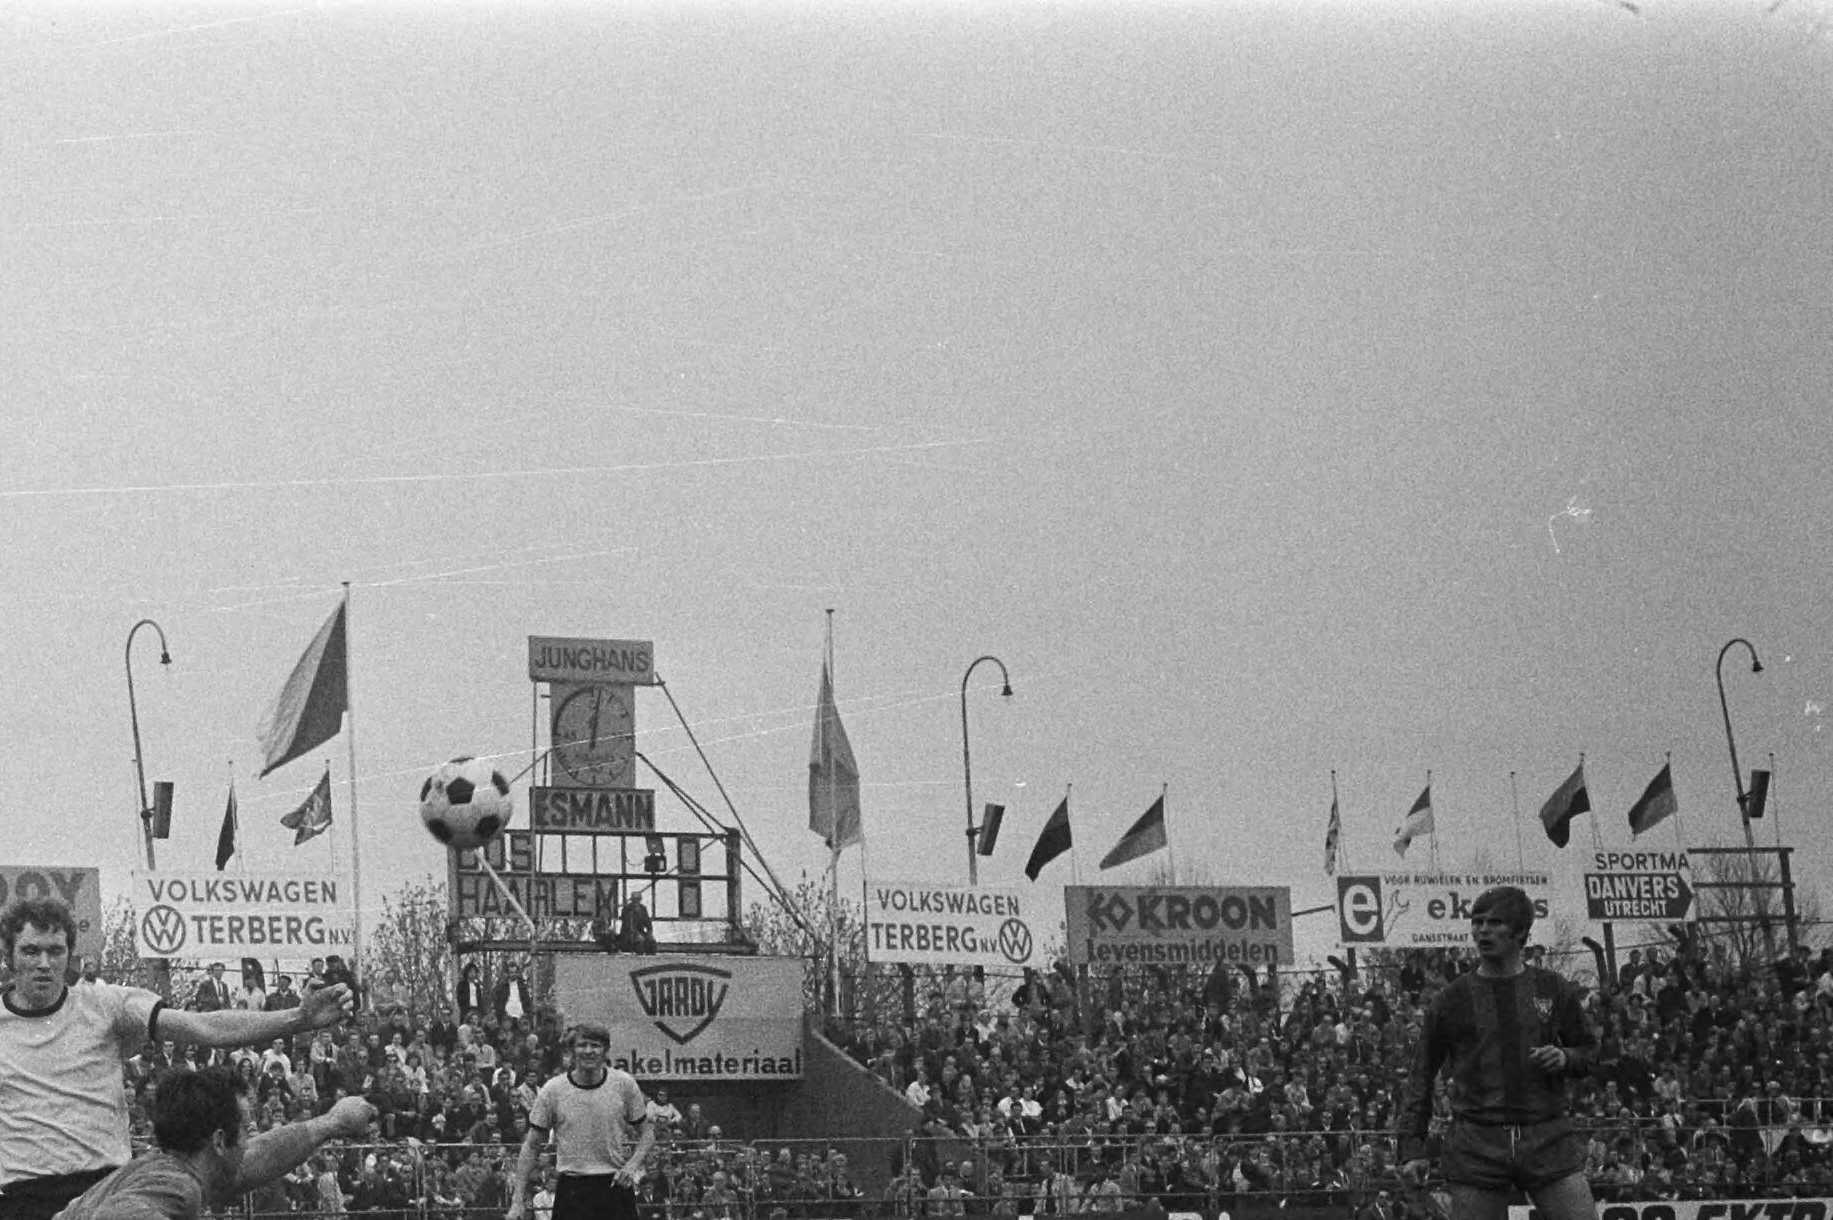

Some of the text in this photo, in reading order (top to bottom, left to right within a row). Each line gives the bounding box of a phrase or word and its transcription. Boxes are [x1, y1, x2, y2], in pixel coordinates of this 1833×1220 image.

[535, 646, 651, 672] JUNGHANS
[1595, 852, 1691, 871] SPORTMA
[147, 878, 338, 903] VOLKSWAGEN
[457, 877, 620, 920] HAARLEM
[1587, 875, 1680, 899] DANVERS
[876, 888, 1020, 917] VOLKSWAGEN
[1136, 894, 1278, 931] KROON
[1604, 899, 1667, 917] UTRECHT
[191, 915, 326, 945] TERBERG
[870, 922, 978, 953] TERBERG
[1086, 938, 1279, 963] levensmiddelen
[614, 1048, 801, 1076] akelmateriaal
